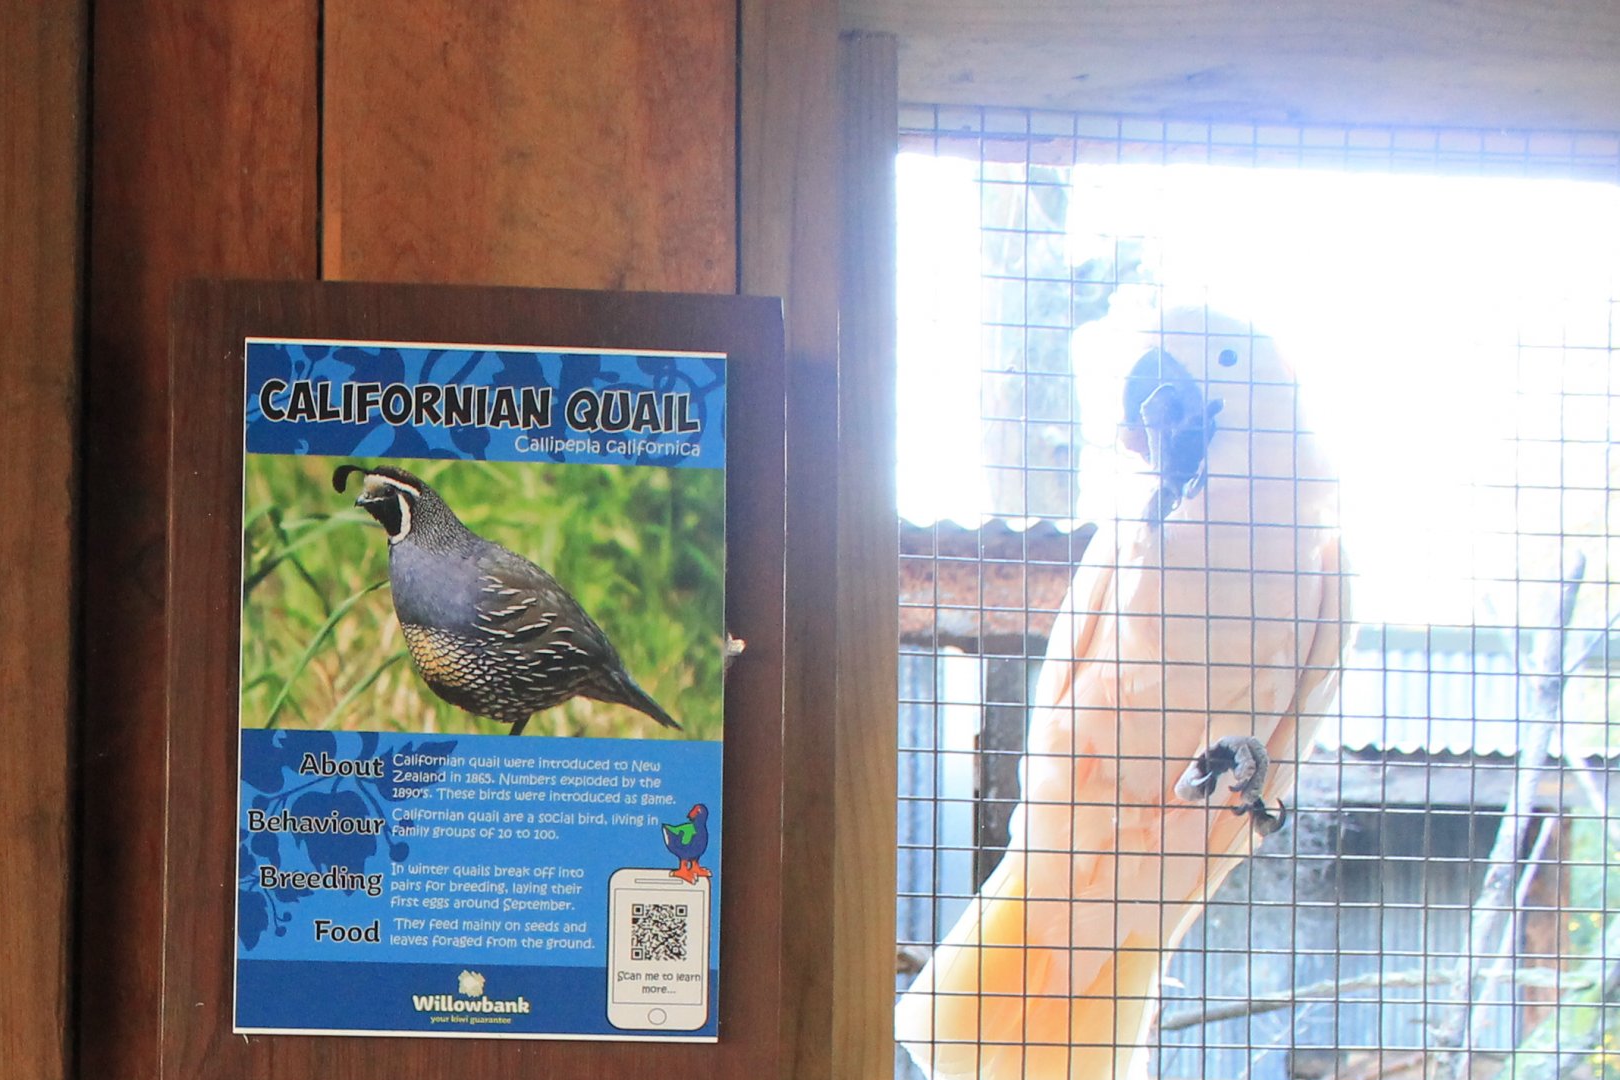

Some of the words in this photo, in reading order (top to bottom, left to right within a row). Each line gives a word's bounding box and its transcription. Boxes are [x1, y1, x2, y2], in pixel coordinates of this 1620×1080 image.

[258, 377, 552, 429] CALIFORNIAN
[565, 388, 701, 435] QUAIL
[514, 435, 601, 455] Callipepla
[605, 437, 701, 457] californica
[299, 751, 384, 778] About
[392, 754, 465, 767] Californian
[468, 755, 501, 769] quail
[503, 757, 535, 769] were
[538, 757, 610, 771] introduced
[613, 760, 629, 772] to
[631, 759, 661, 772] New
[392, 770, 446, 783] Zealand
[449, 772, 462, 783] in
[465, 773, 496, 784] 1865.
[498, 773, 557, 786] Numbers
[560, 774, 619, 788] exploded
[621, 776, 637, 789] by
[639, 777, 662, 789] the
[247, 809, 386, 835] Behaviour
[258, 865, 383, 897] Breeding
[390, 896, 420, 909] first
[422, 897, 450, 910] eggs
[453, 897, 500, 910] around
[502, 897, 576, 912] September.
[313, 918, 381, 944] Food
[389, 935, 429, 947] leaves
[431, 935, 483, 948] foraged
[485, 936, 517, 948] from
[521, 936, 543, 949] the
[546, 937, 596, 951] ground.
[617, 971, 642, 983] Scan
[644, 972, 660, 982] me
[661, 972, 674, 982] to
[675, 972, 701, 983] learn
[641, 985, 676, 995] more...
[412, 995, 531, 1014] Willowbank
[429, 1016, 450, 1025] your
[450, 1014, 469, 1024] kiwi
[470, 1016, 512, 1026] guarantee
